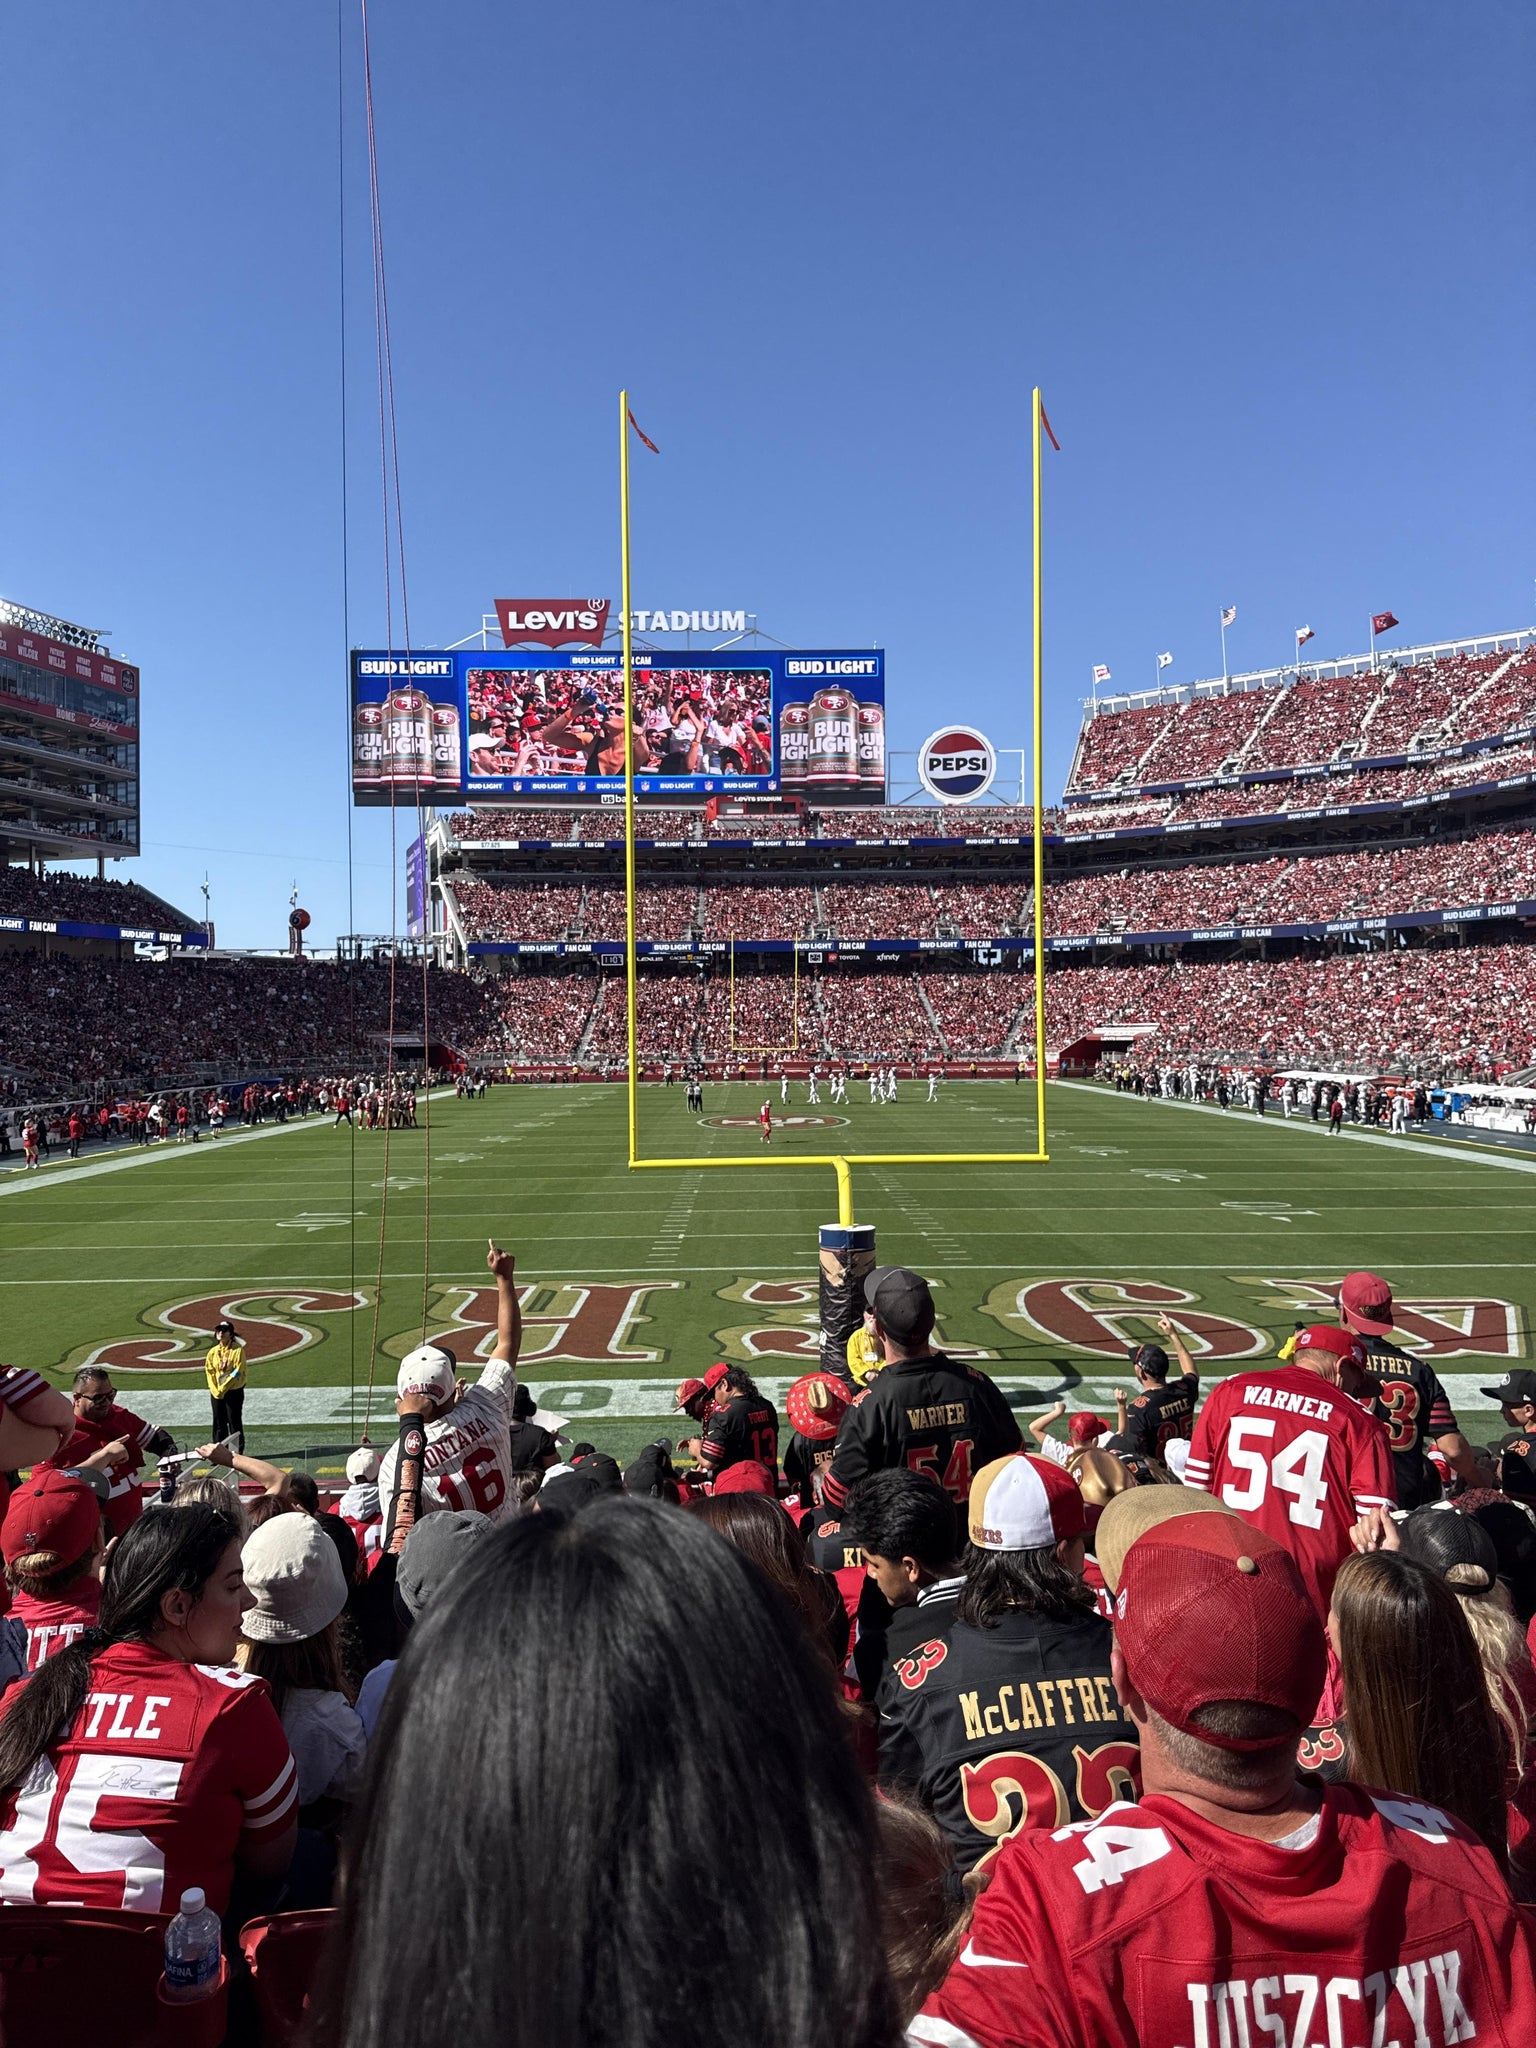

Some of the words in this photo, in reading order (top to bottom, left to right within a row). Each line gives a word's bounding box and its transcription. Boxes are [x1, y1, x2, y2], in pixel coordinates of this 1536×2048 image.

[617, 610, 746, 632] STADIUM
[361, 661, 398, 674] BUD
[400, 661, 450, 674] LIGHT
[635, 656, 652, 665] CAM
[788, 660, 824, 674] BUD
[824, 660, 876, 674] LIGHT
[56, 708, 75, 722] HOME
[388, 721, 427, 738] BUD
[814, 721, 852, 737] BUD
[383, 737, 434, 755] LIGHT
[809, 736, 857, 754] LIGHT
[928, 757, 987, 771] PEPSI
[615, 795, 638, 803] bak
[1443, 912, 1458, 920] BUD
[1459, 909, 1481, 918] LIGHT
[1488, 907, 1501, 916] FAN
[1501, 904, 1516, 915] CAM
[30, 921, 42, 931] FAN
[43, 922, 56, 932] CAM
[1242, 929, 1255, 937] FAN
[1256, 928, 1271, 936] CAM
[1340, 922, 1358, 930] LIGHT
[1364, 920, 1373, 928] FAN
[1375, 919, 1386, 928] CAM
[121, 930, 135, 938] BUD
[136, 931, 155, 940] LIGHT
[160, 933, 171, 941] FAN
[171, 934, 181, 943] CAM
[876, 953, 900, 961] xfinity
[1365, 1354, 1412, 1376] AFFREY
[1243, 1385, 1333, 1421] WARNER
[906, 1403, 966, 1432] WARNER
[424, 1418, 490, 1473] ONTANA
[751, 1428, 778, 1466] 13
[814, 1449, 836, 1465] BOS
[437, 1446, 506, 1514] 16
[906, 1439, 977, 1503] 54
[1222, 1416, 1330, 1530] 54
[843, 1547, 863, 1567] KI
[26, 1623, 84, 1669] TT
[62, 1694, 172, 1740] TLE
[959, 1676, 1134, 1741] McCAFFRE
[1187, 1950, 1477, 2048] JUSZCZYK
